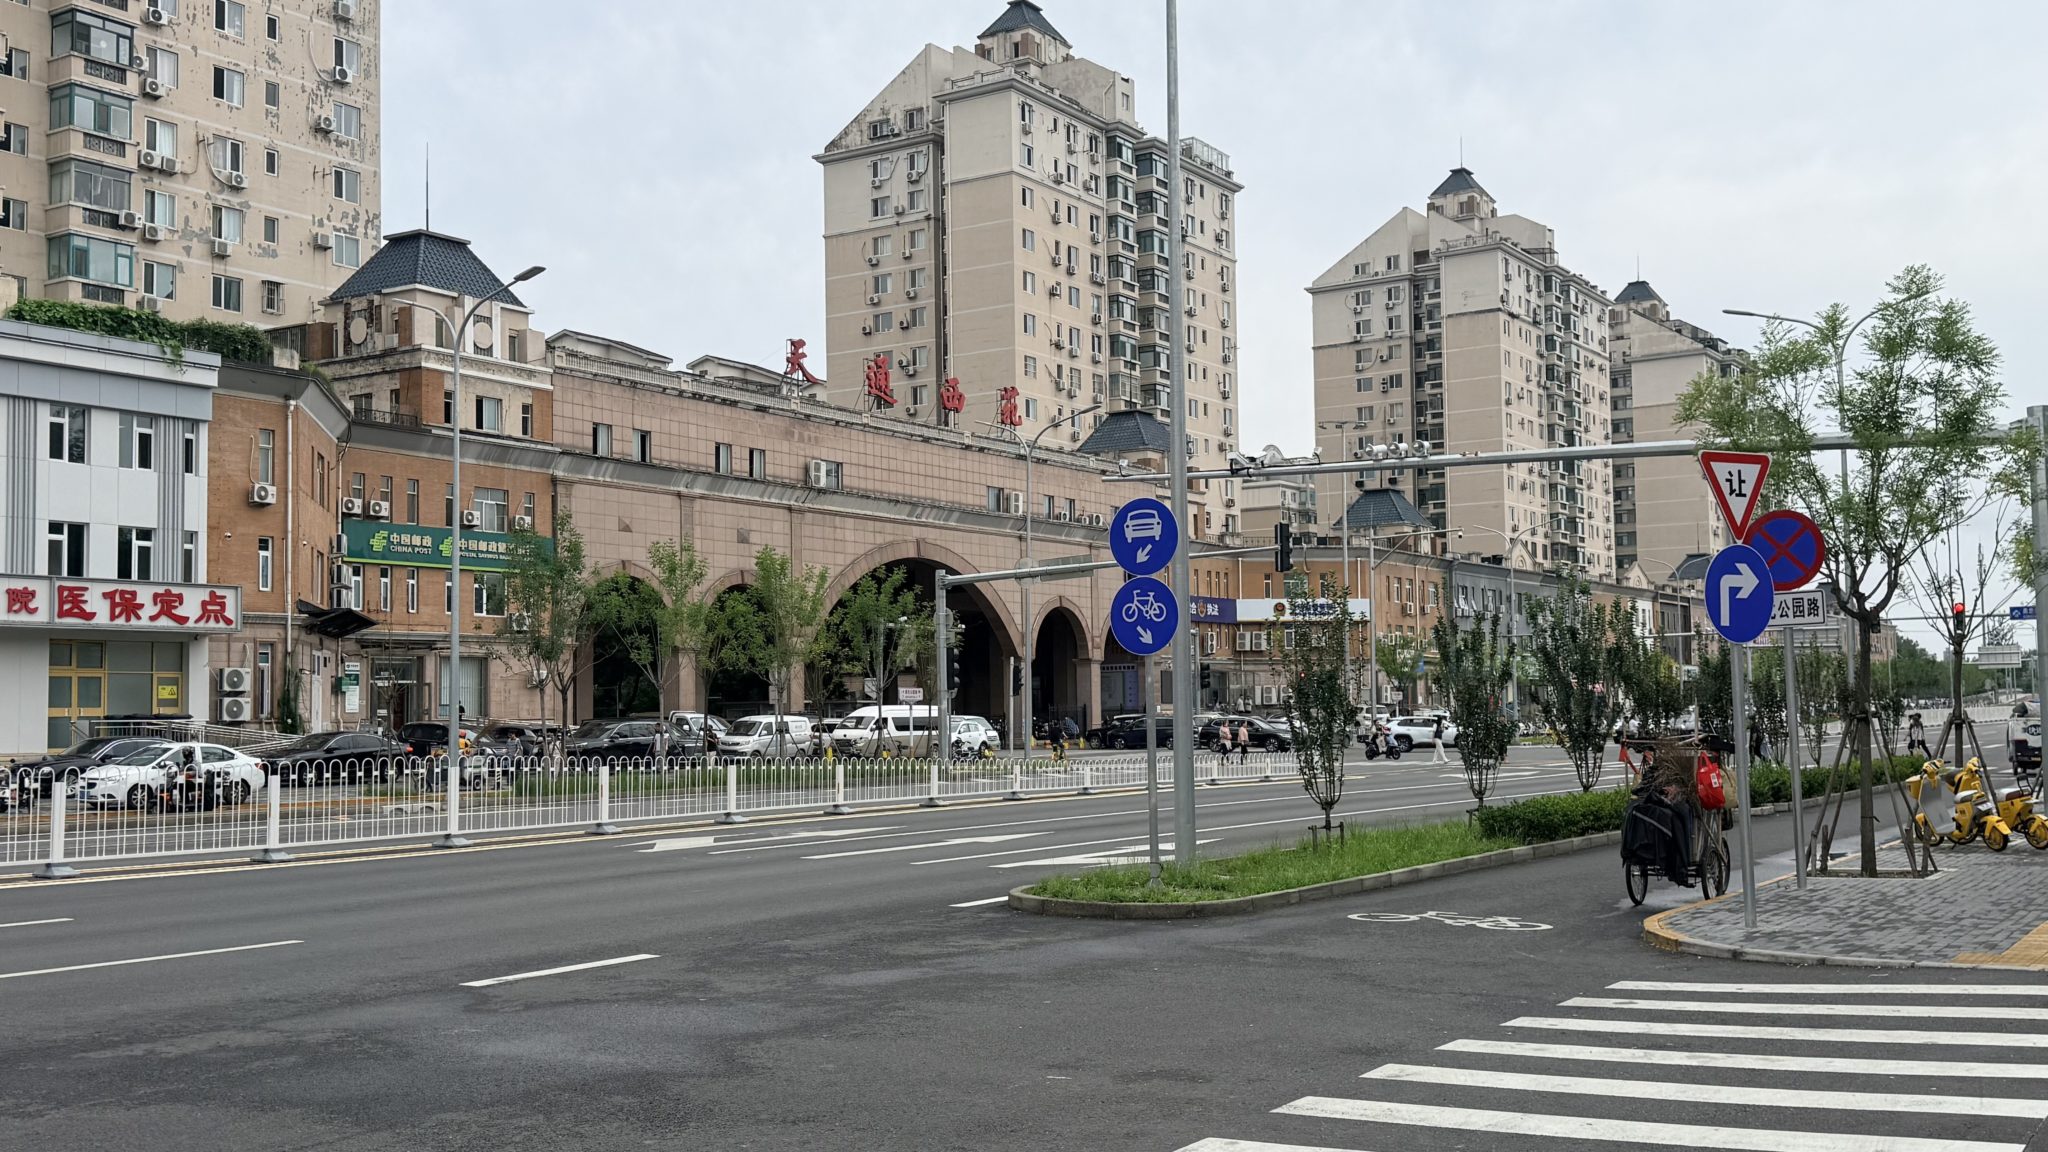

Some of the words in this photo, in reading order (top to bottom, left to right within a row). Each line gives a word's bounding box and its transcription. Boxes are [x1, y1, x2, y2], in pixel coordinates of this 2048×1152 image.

[1725, 469, 1748, 498] 让
[390, 532, 432, 547] 中国邮政
[390, 545, 413, 554] CHINA
[414, 547, 432, 555] POST
[5, 586, 39, 615] 院
[57, 584, 234, 626] 医保定点
[1771, 596, 1820, 619] 公园路
